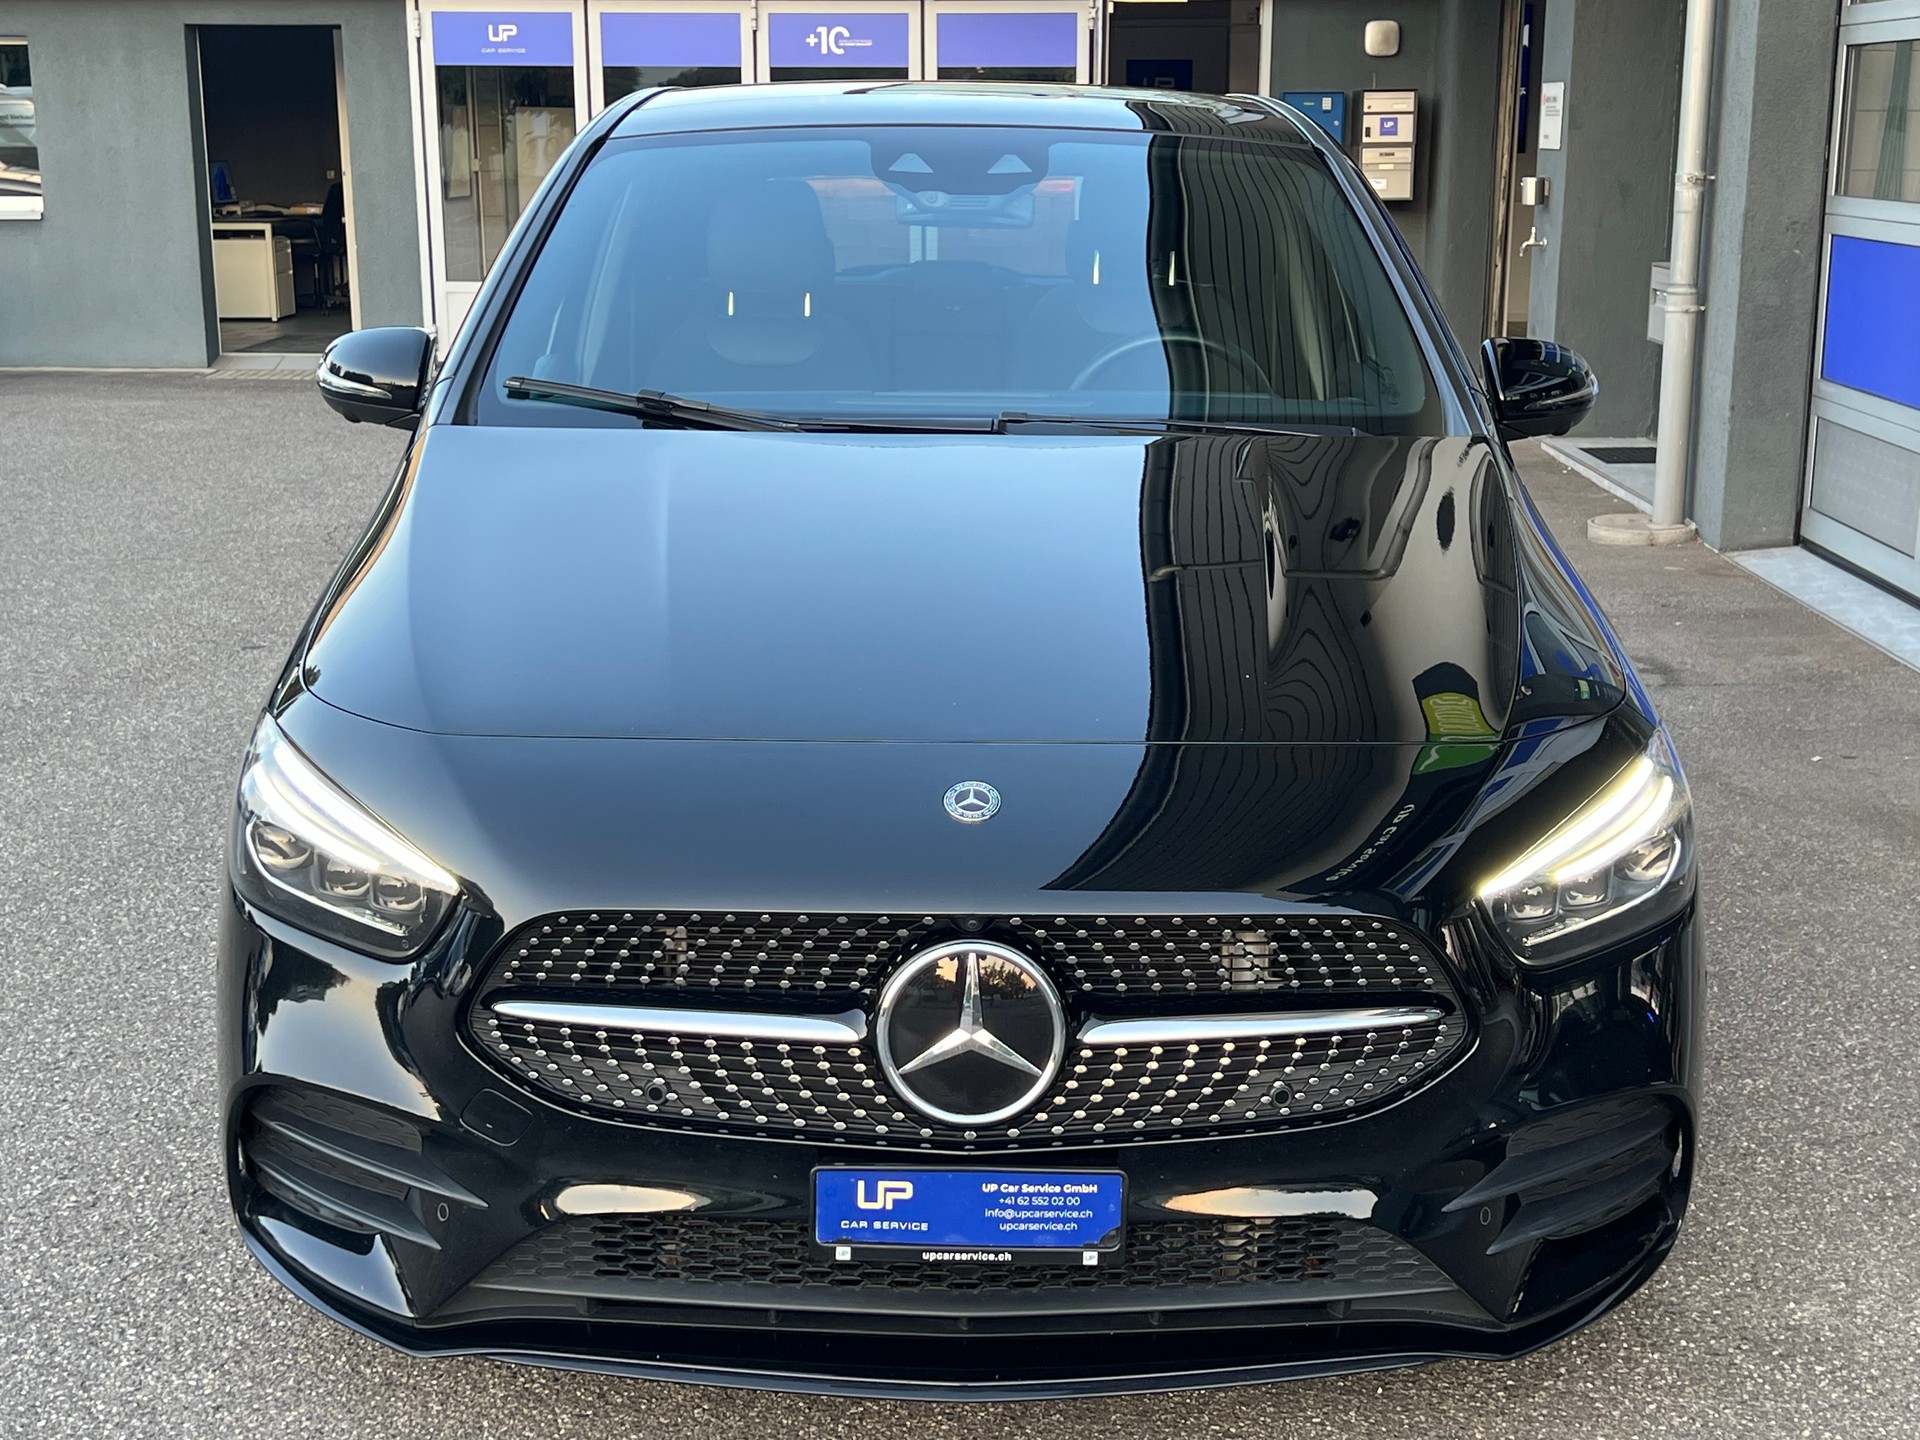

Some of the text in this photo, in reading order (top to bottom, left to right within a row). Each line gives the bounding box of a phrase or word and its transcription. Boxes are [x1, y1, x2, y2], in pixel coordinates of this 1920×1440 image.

[488, 24, 517, 42] UP
[981, 1183, 1098, 1194] UP Car Service GmbH
[857, 1180, 913, 1210] UP
[999, 1196, 1081, 1206] +41 62 552 02 00
[985, 1208, 1093, 1220] info@upcarservice.ch
[840, 1220, 929, 1231] CAR SERVICE
[999, 1221, 1078, 1232] upcarservice.ch
[922, 1251, 1012, 1262] upcarservice.ch
